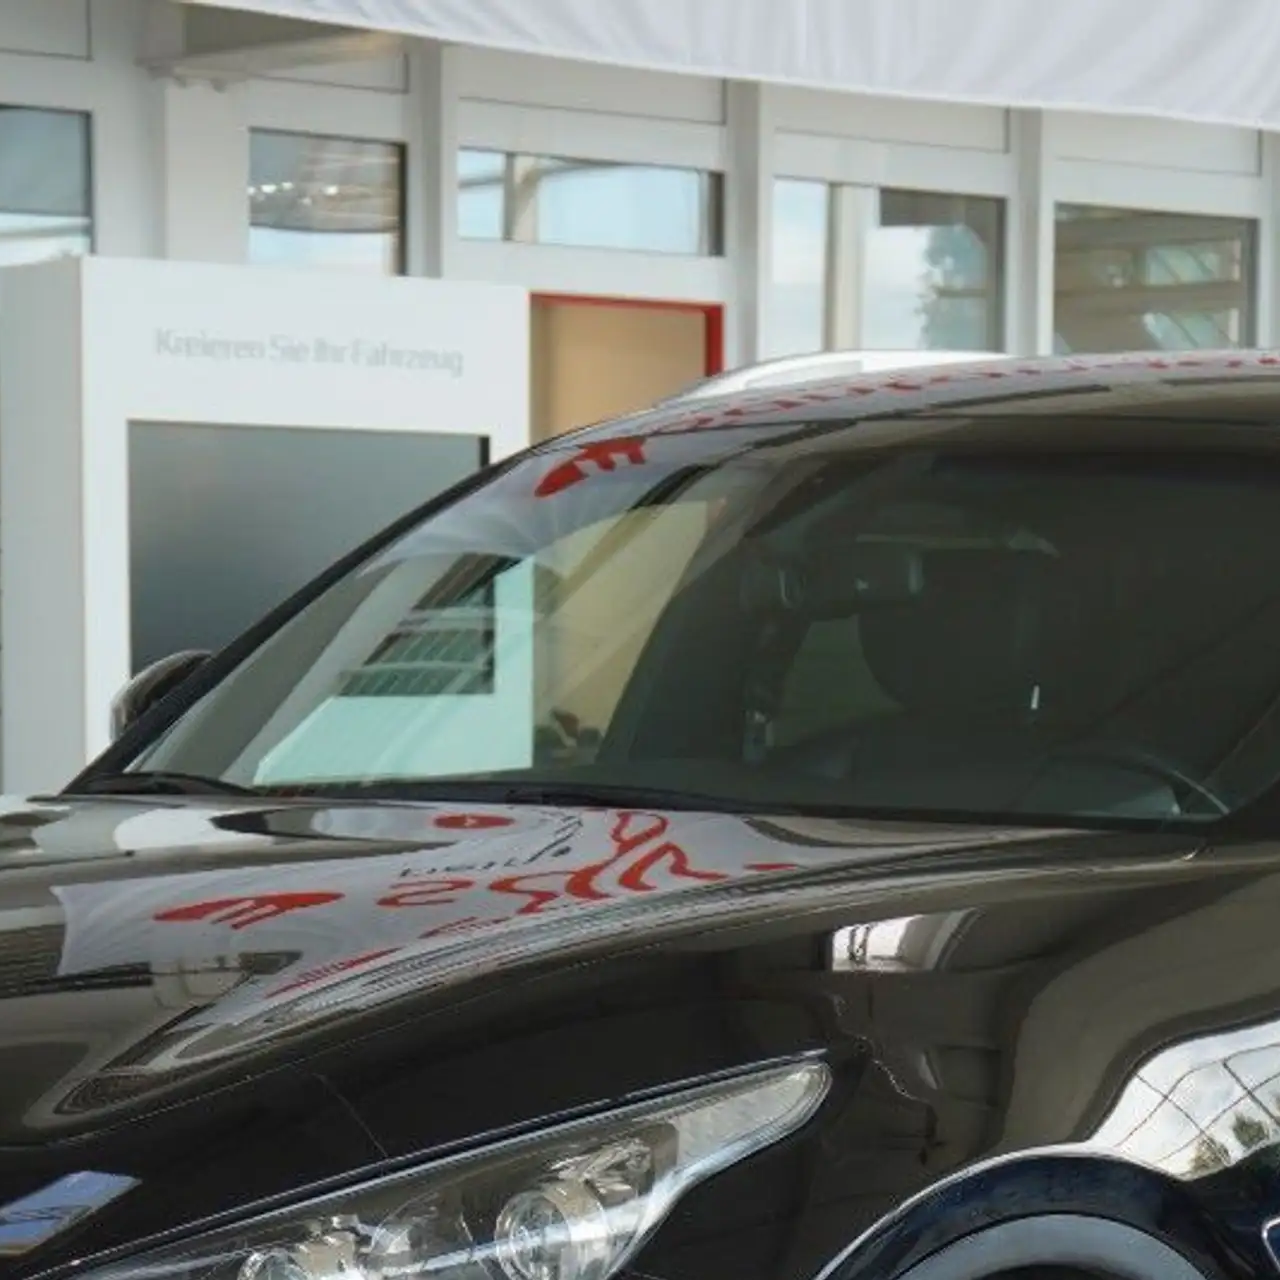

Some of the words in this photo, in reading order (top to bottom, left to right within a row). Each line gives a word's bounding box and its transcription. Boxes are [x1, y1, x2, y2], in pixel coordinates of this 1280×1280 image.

[156, 328, 265, 361] Kreieren
[269, 333, 310, 363] Sie
[313, 337, 347, 364] Ihr
[350, 338, 464, 378] Fahrzeug
